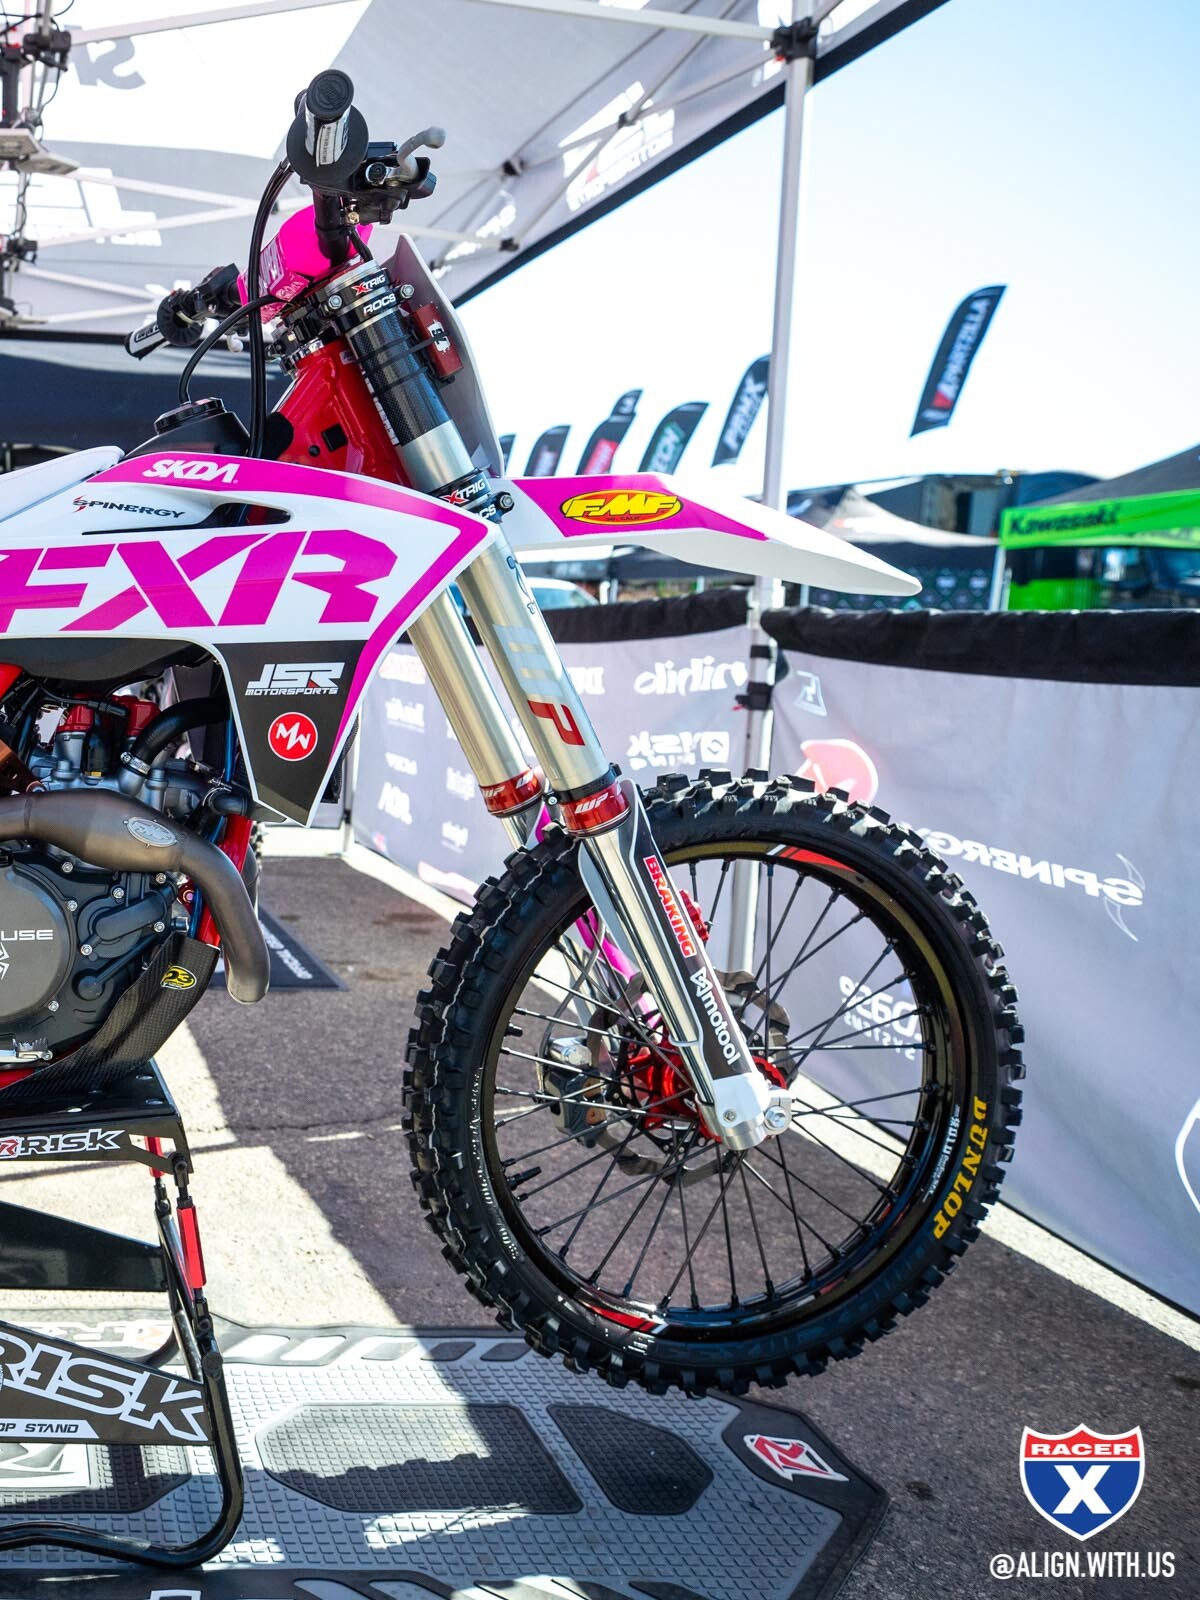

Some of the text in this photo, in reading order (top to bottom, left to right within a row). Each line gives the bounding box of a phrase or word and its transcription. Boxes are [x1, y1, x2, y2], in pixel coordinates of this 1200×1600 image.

[352, 275, 386, 296] XTRIG
[363, 293, 397, 317] ROCS
[143, 460, 238, 484] SKDA
[73, 496, 186, 520] SPINERGY
[565, 493, 678, 518] FMF
[246, 662, 346, 689] JSR
[244, 686, 339, 697] MOTORSPORTS
[575, 792, 610, 815] WP
[644, 855, 698, 958] BRAKING
[697, 986, 741, 1067] motool
[19, 1128, 124, 1158] RISK
[932, 1096, 989, 1240] DUNLOP
[24, 1423, 80, 1434] STAND
